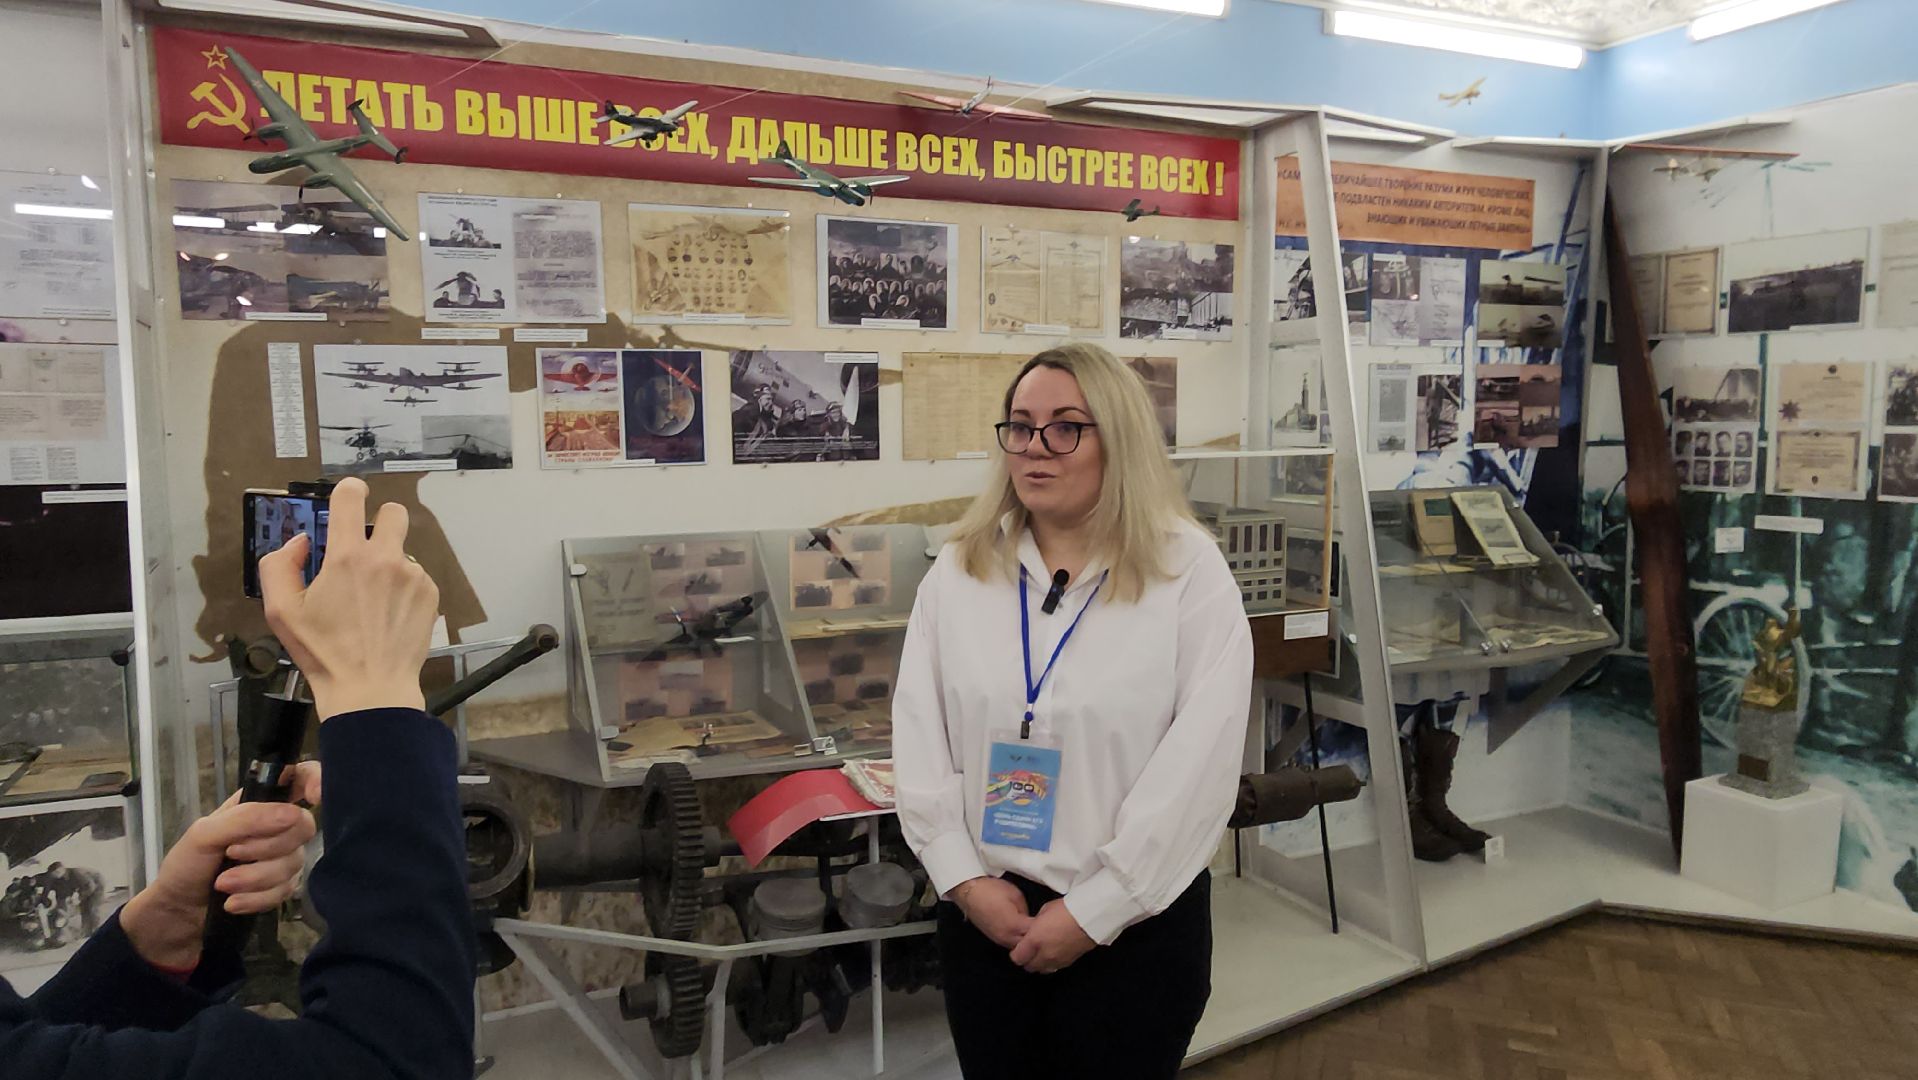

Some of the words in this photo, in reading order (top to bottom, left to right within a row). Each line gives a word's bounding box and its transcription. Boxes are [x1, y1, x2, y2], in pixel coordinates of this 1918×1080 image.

[455, 89, 599, 145] ВЫШЕ
[726, 116, 888, 169] ДАЛЬШЕ
[896, 131, 985, 181] ВСЕХ,
[993, 141, 1134, 189] БЫСТРЕЕ
[1140, 154, 1209, 195] ВСЕХ
